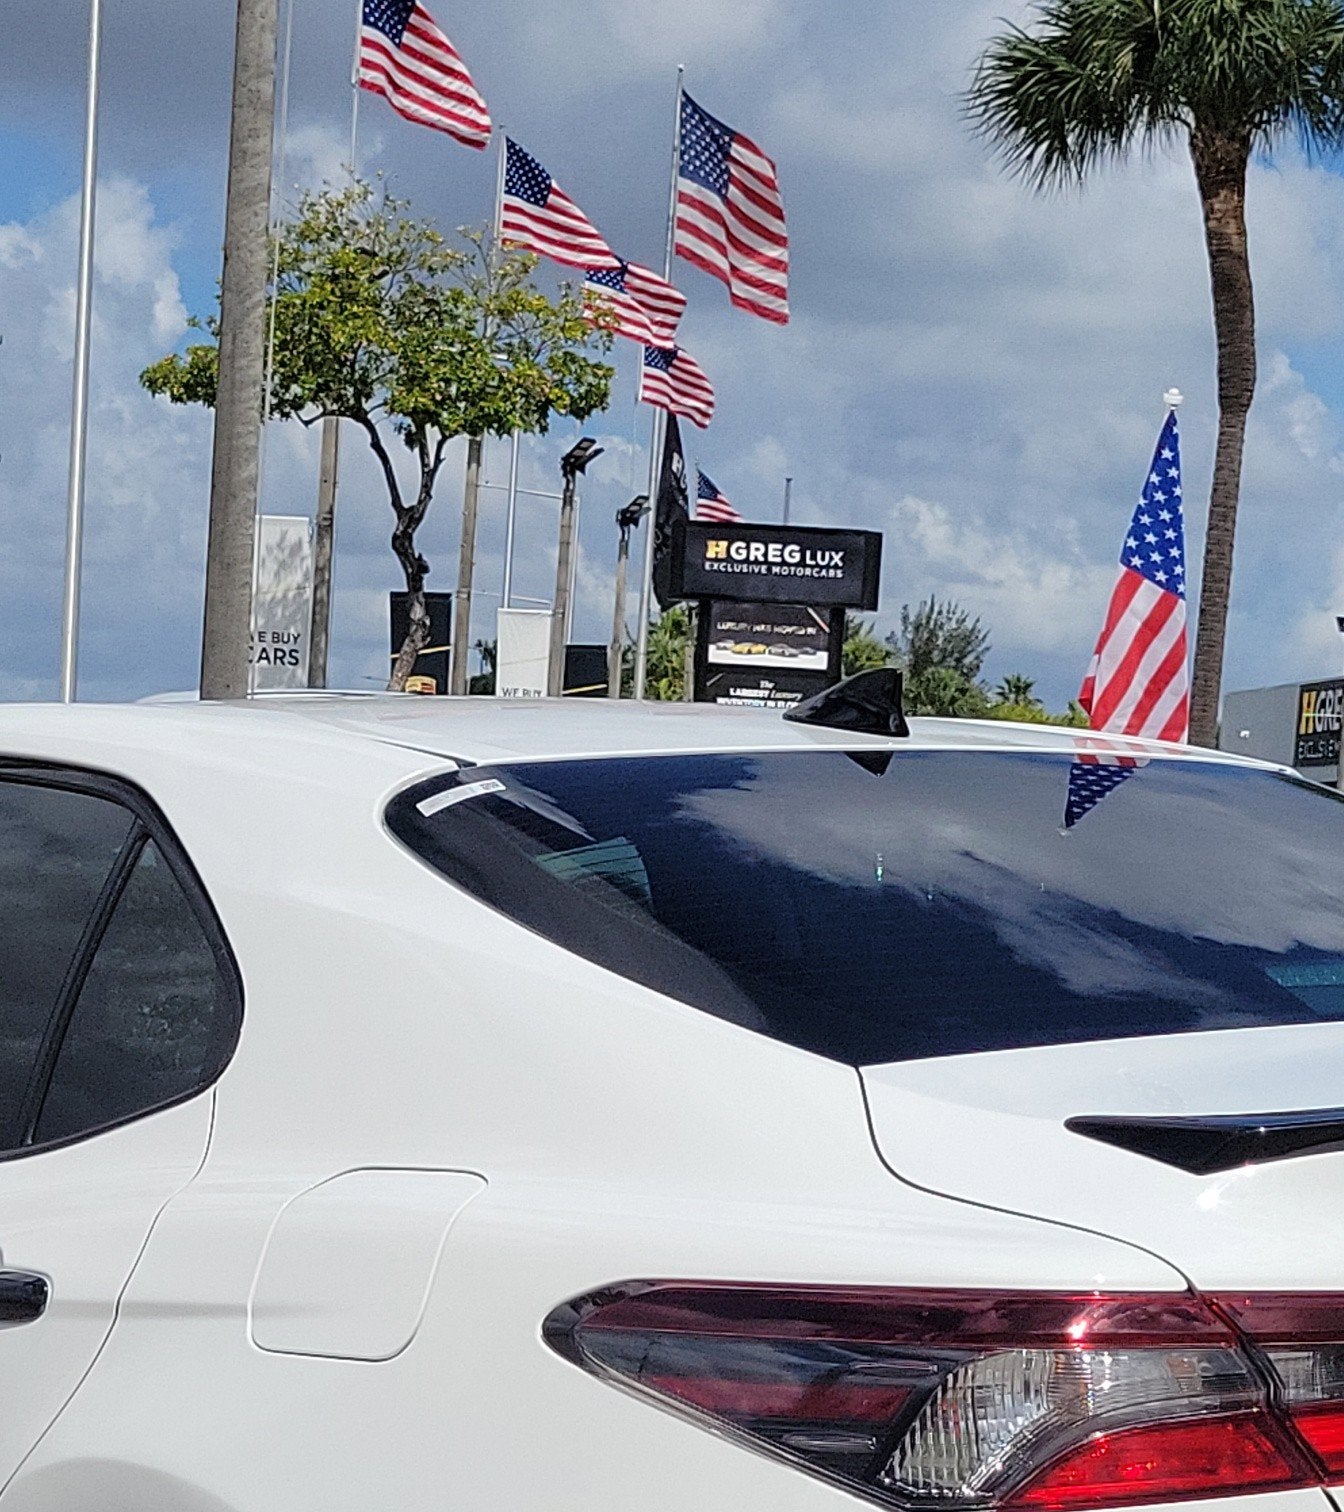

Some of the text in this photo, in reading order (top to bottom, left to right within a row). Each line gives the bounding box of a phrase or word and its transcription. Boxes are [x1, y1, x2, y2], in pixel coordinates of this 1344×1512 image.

[805, 549, 845, 567] LUX
[704, 561, 844, 578] EXCLUSIVE MOTORCARS
[271, 630, 301, 645] BUY
